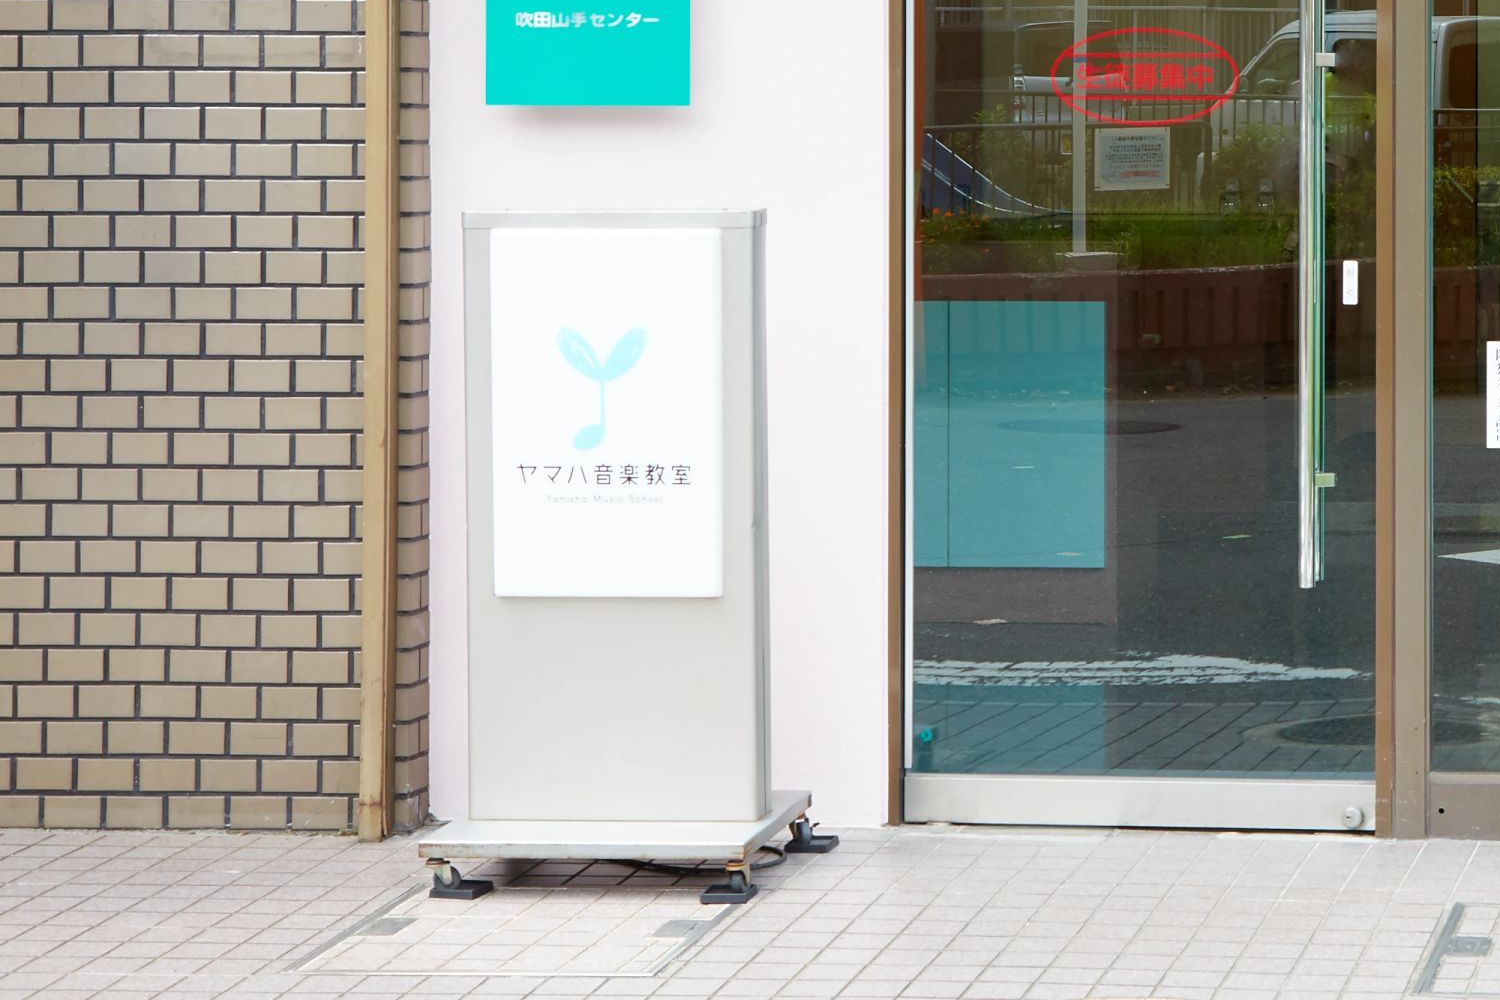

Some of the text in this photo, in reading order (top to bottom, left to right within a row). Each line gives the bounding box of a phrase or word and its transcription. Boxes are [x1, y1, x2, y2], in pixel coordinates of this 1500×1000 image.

[515, 11, 660, 28] 吹田山手センター
[1075, 62, 1214, 90] 生徒募集中
[516, 463, 692, 486] ヤマハ音楽教室
[546, 495, 588, 504] Yamaha
